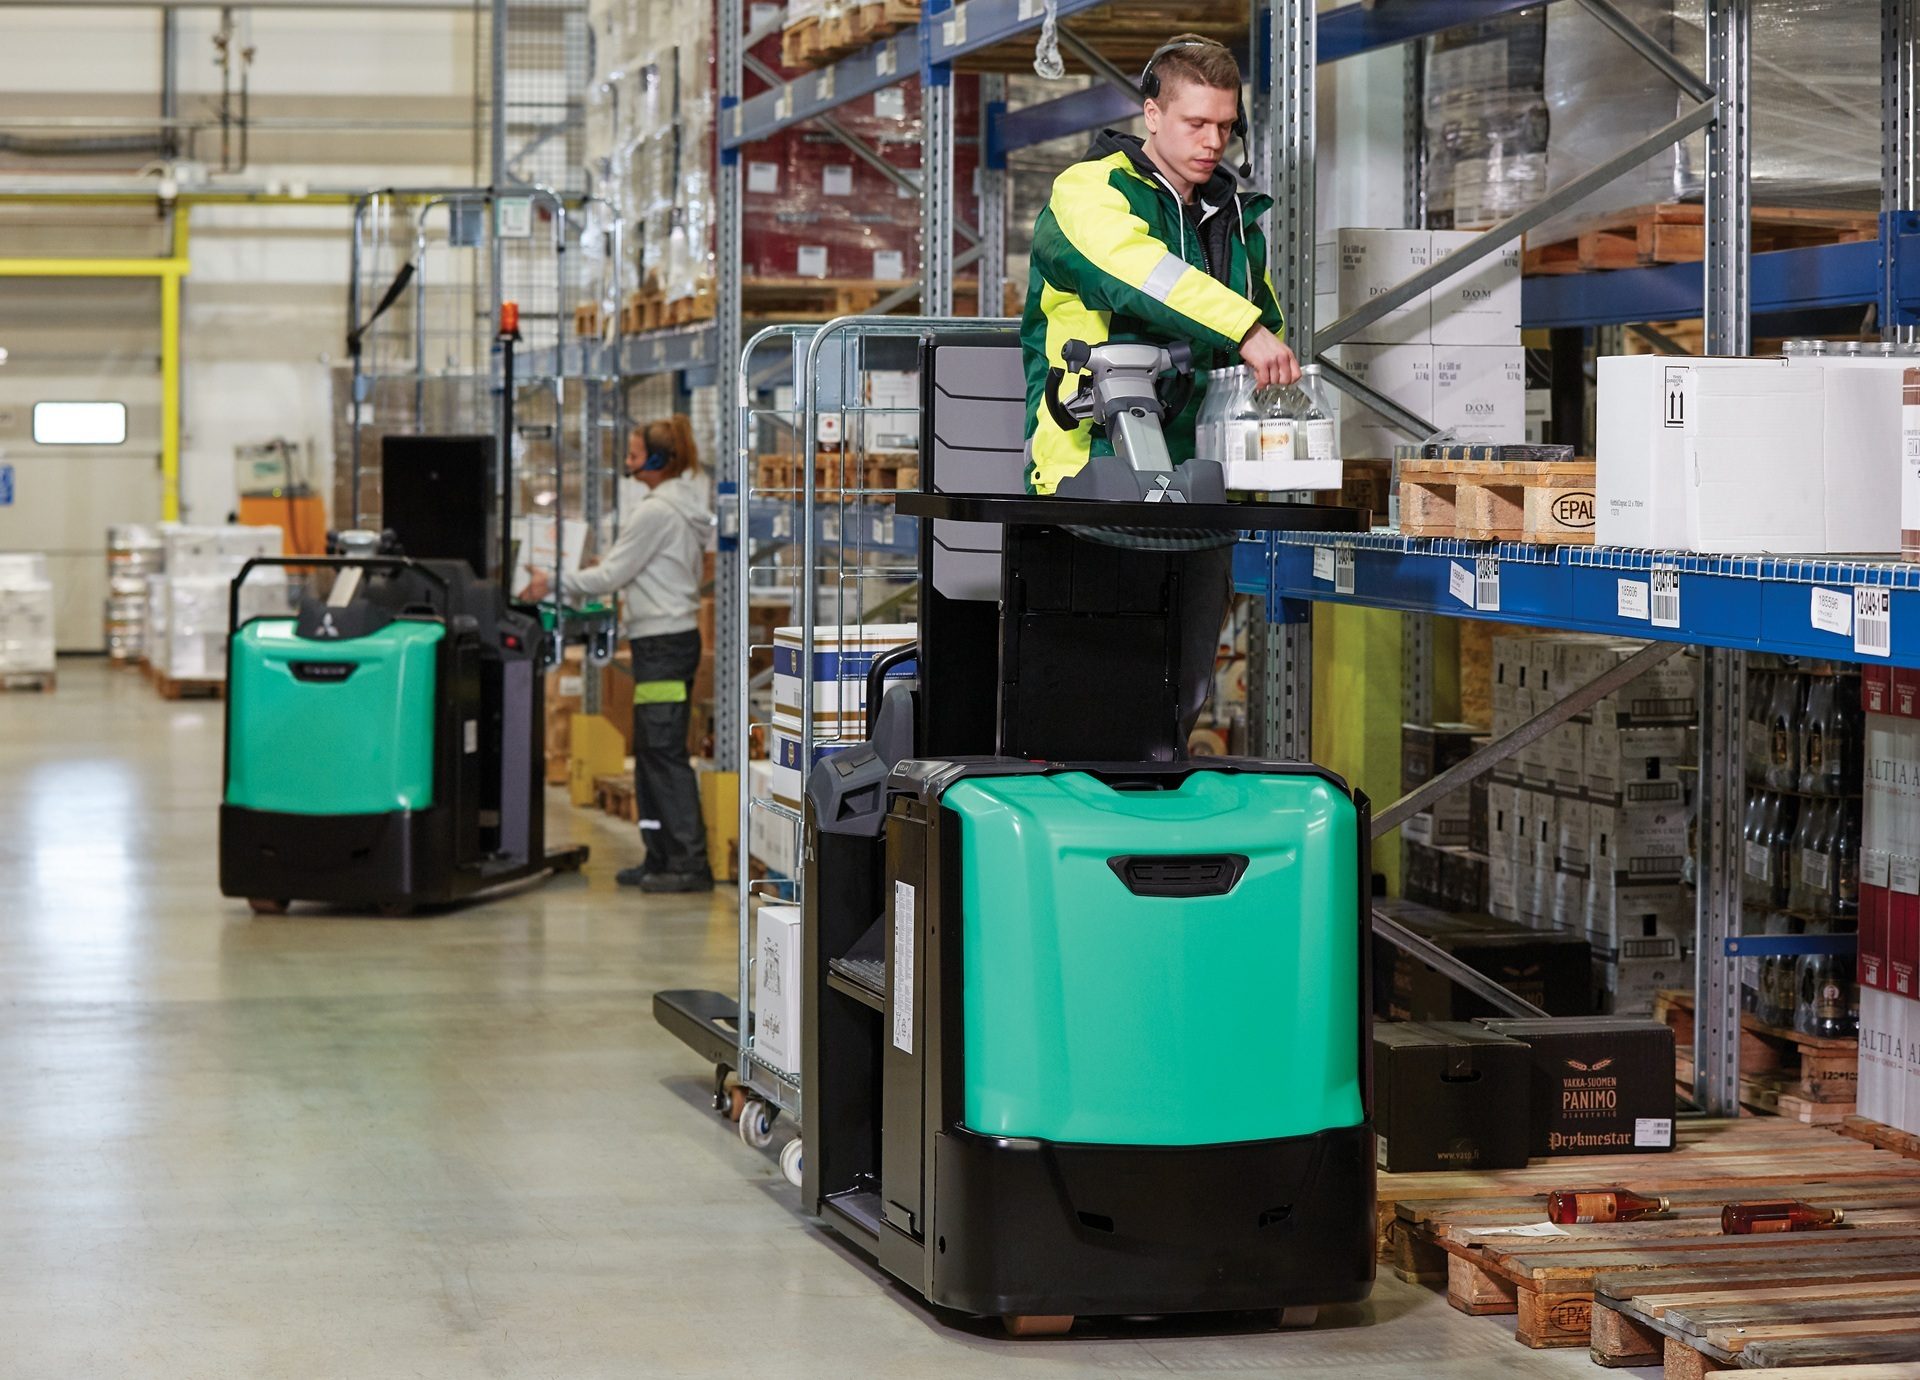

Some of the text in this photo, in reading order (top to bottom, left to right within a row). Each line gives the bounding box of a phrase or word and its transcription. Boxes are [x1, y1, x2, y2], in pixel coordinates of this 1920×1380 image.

[1560, 500, 1596, 519] EPAL
[1860, 1028, 1903, 1059] ALTIA
[1563, 1077, 1617, 1088] VAKKA-SUOMEN
[1562, 1090, 1617, 1110] PANIMO
[1549, 1132, 1632, 1150] Prykmestar
